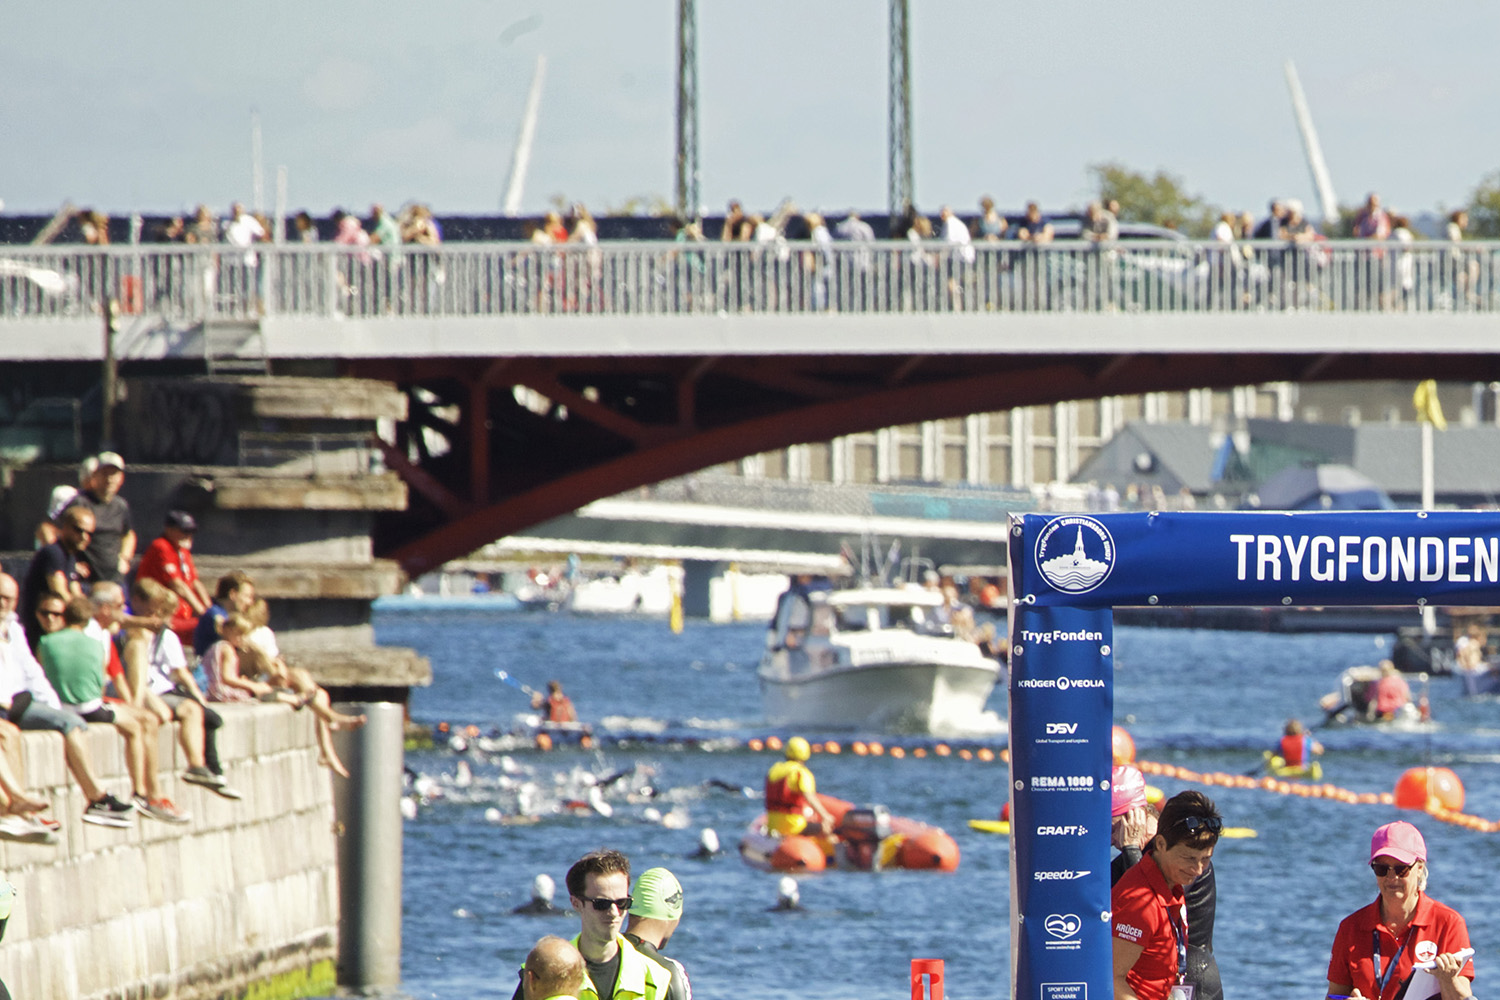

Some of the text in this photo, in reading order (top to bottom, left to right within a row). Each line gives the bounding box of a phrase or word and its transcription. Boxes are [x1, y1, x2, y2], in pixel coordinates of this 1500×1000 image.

[1230, 535, 1498, 582] TRYGFONDEN
[1021, 630, 1102, 644] TrygFonden
[1018, 678, 1105, 688] KRÜGER VEOLIA
[1046, 723, 1078, 734] DSV
[1031, 776, 1093, 787] REMA 1000
[1037, 825, 1077, 836] CRAFT
[1034, 869, 1073, 882] speedo
